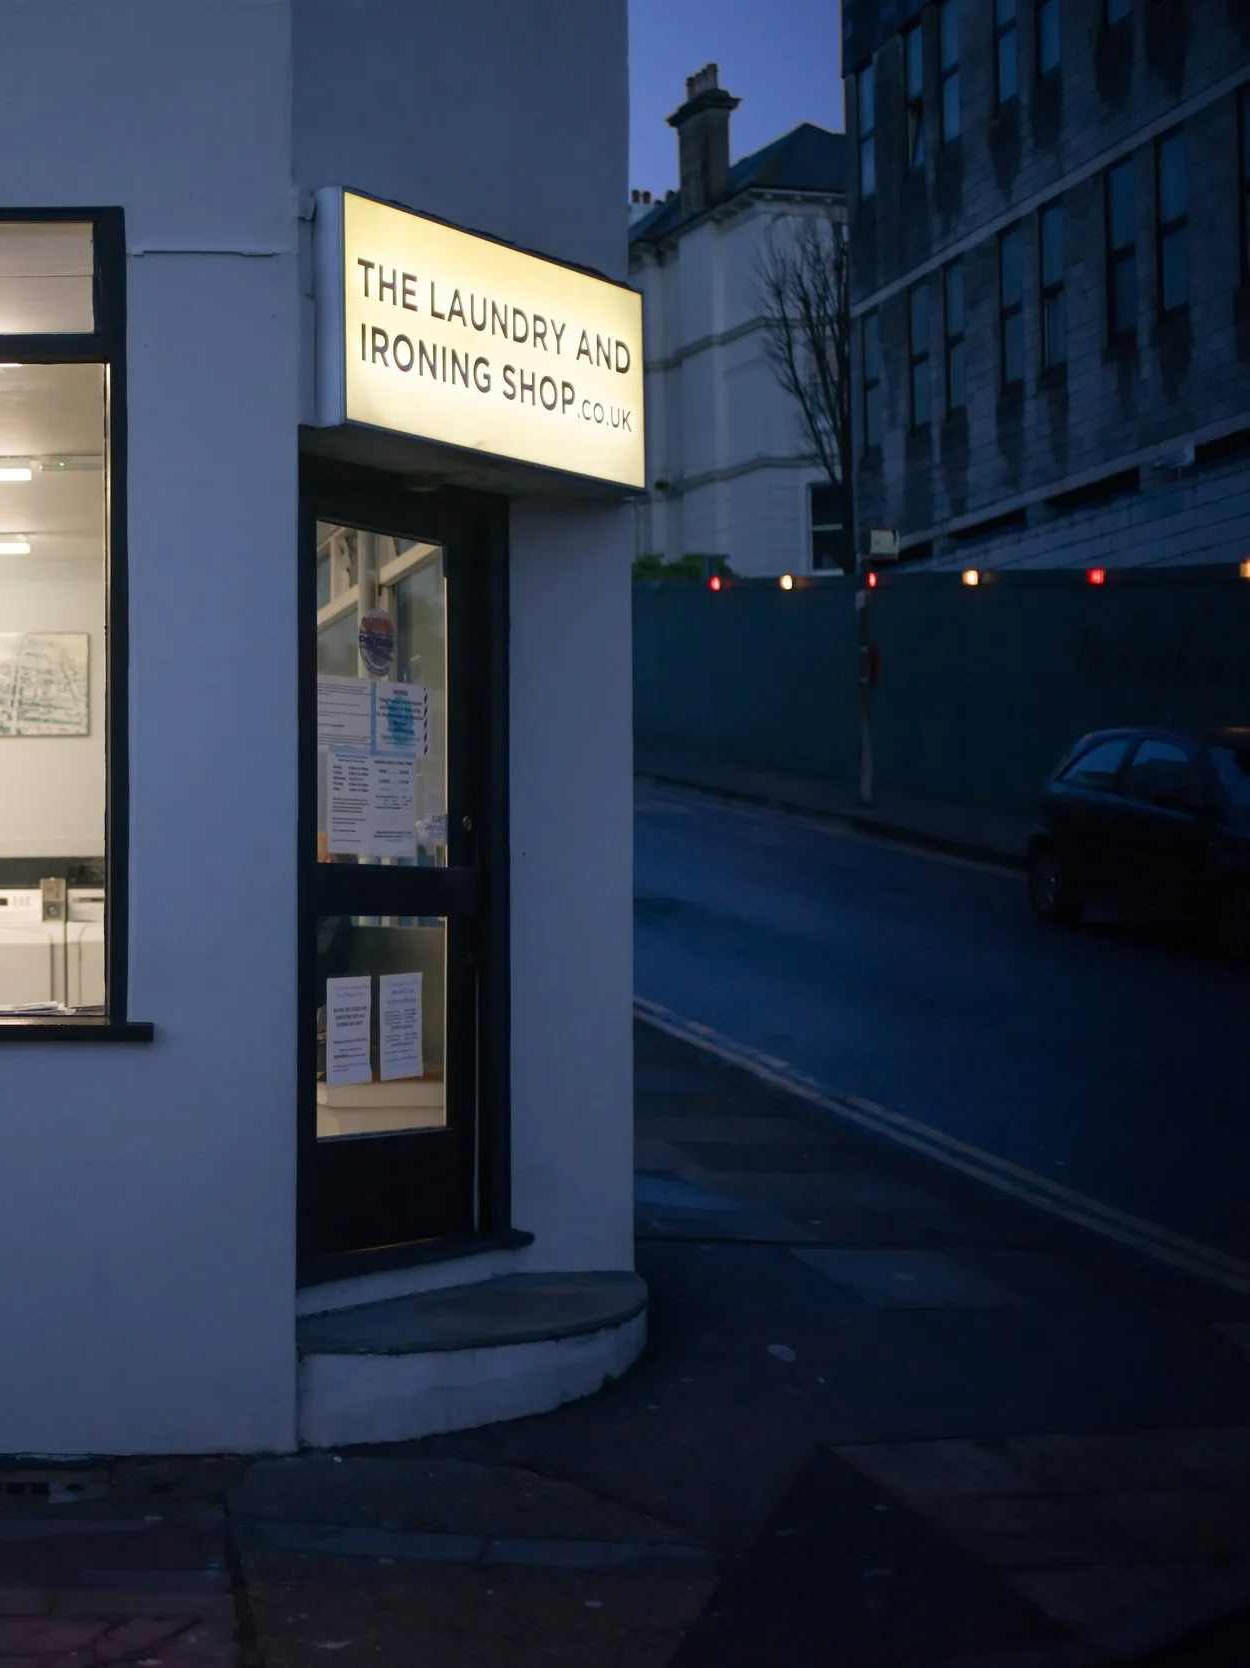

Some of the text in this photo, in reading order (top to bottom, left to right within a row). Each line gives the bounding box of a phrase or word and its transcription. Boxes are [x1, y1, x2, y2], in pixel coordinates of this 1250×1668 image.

[357, 257, 631, 374] THE LAUNDRY AND
[360, 322, 491, 394] IRONING
